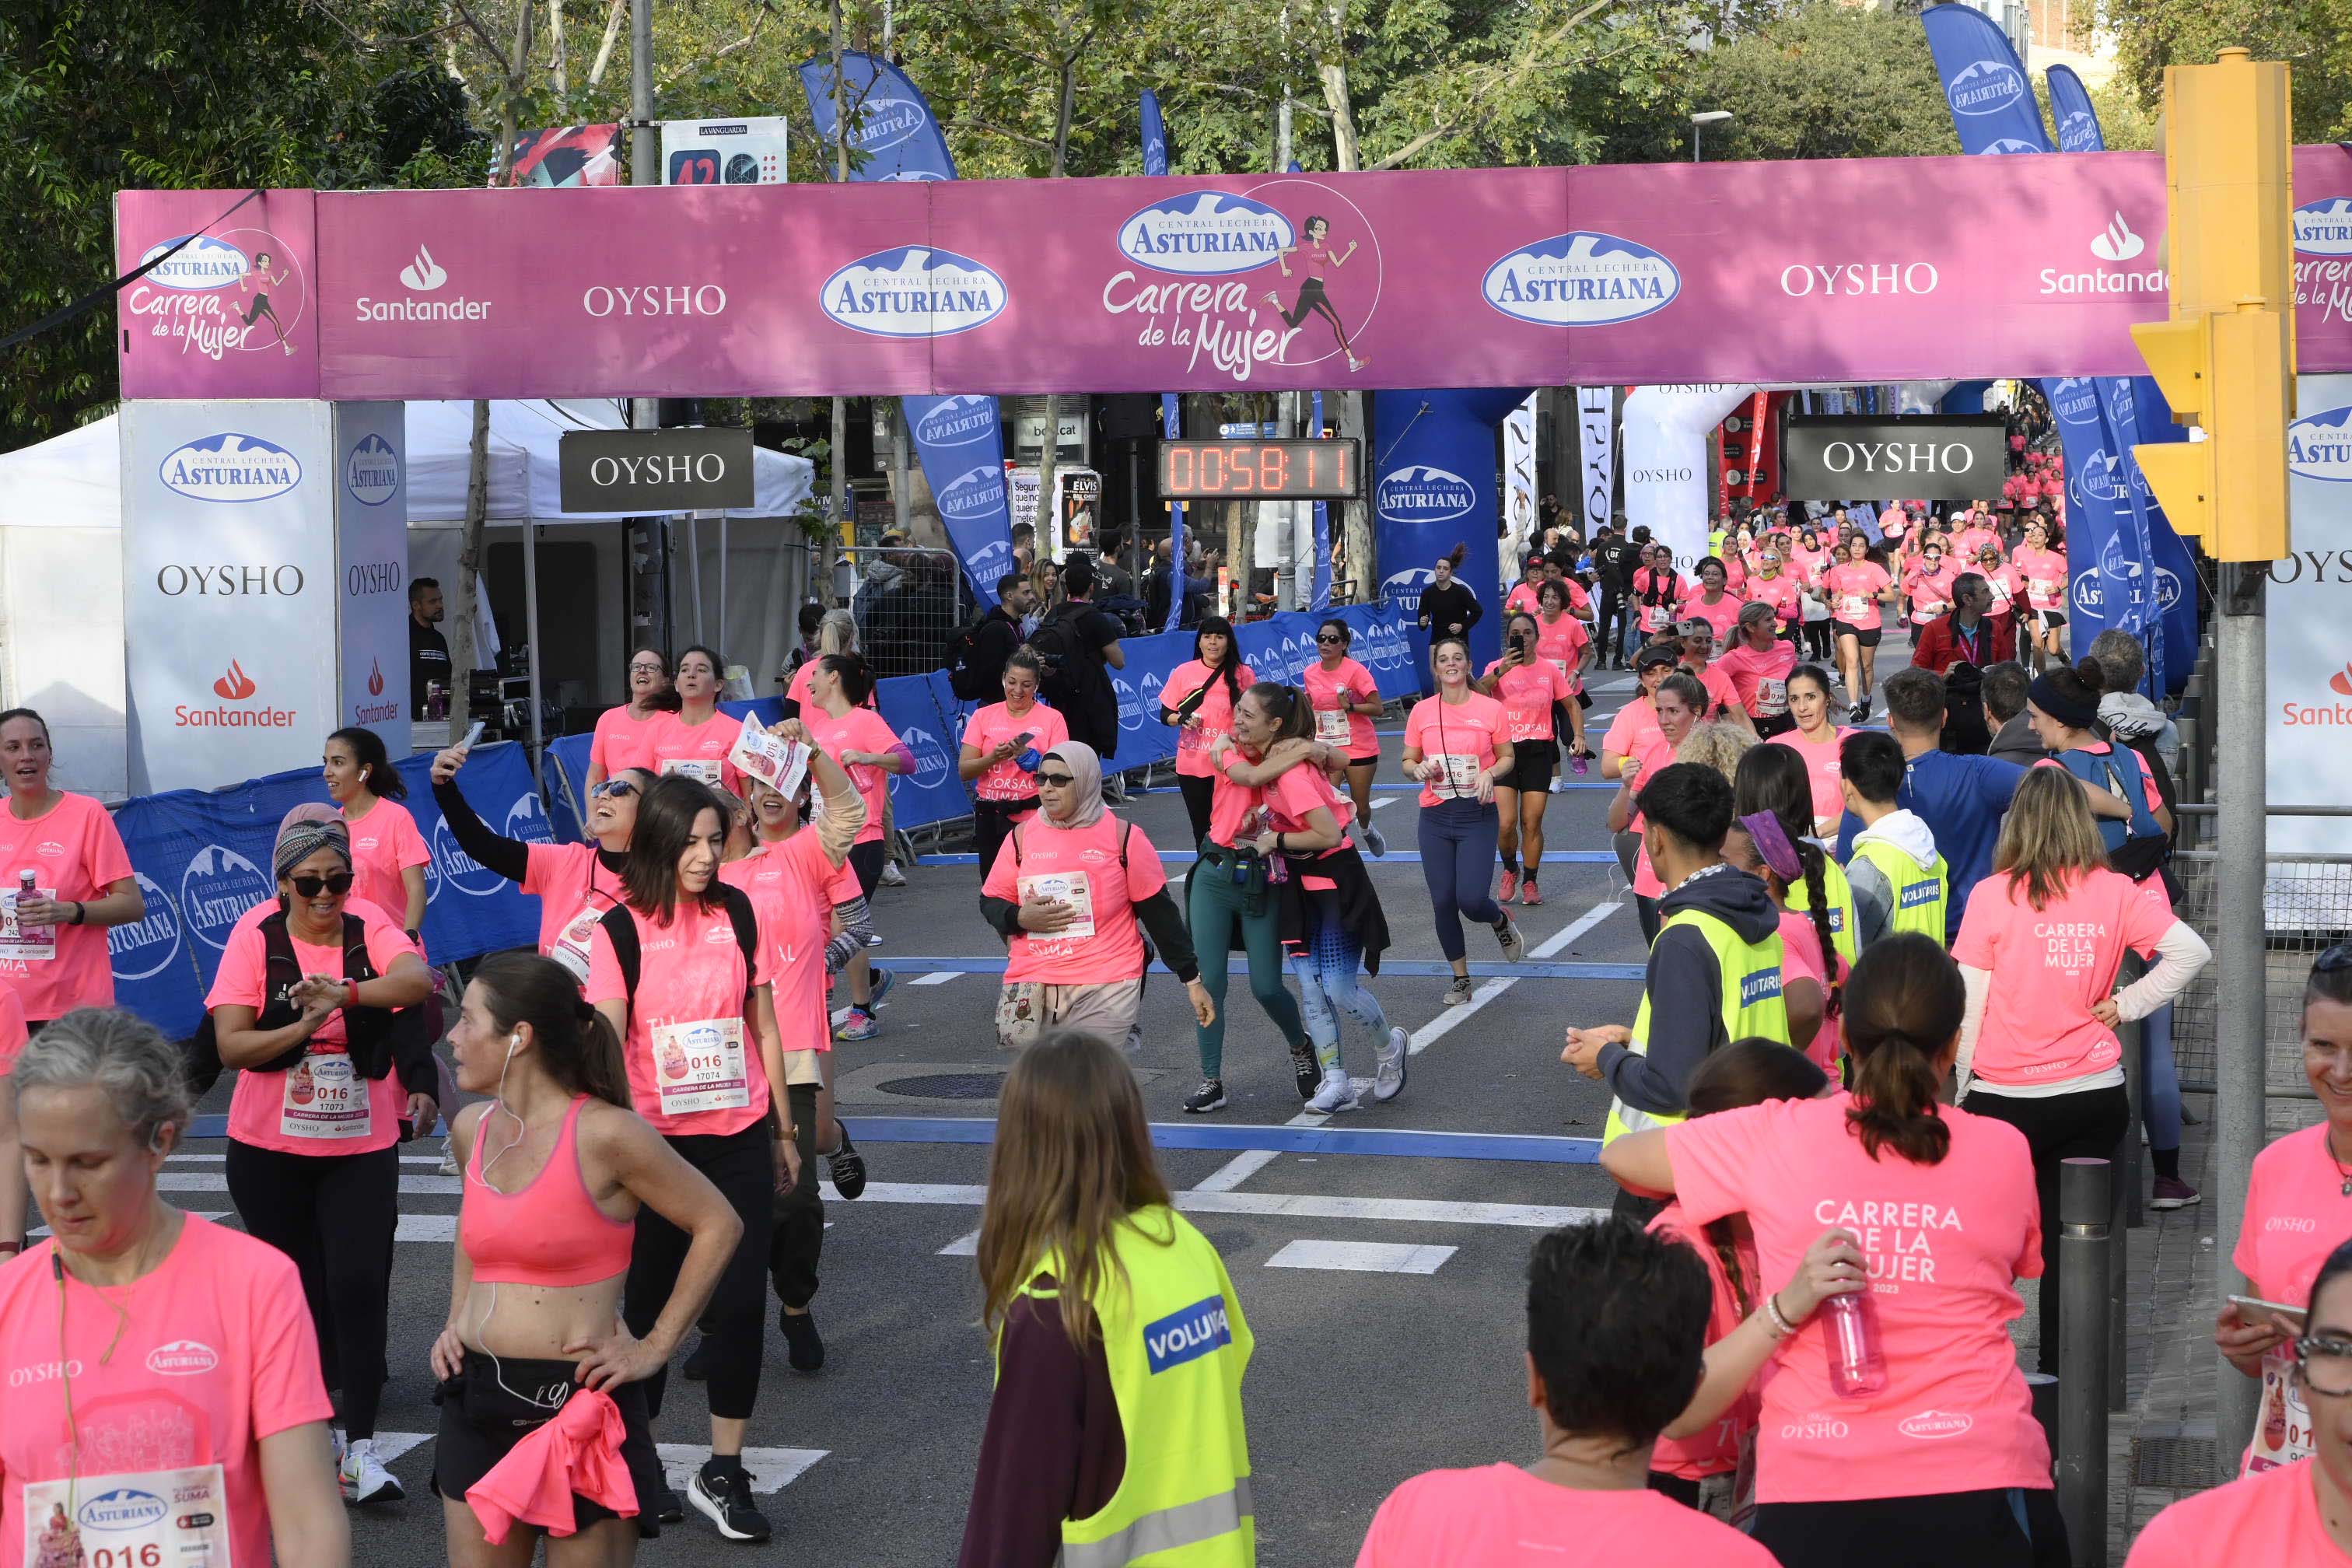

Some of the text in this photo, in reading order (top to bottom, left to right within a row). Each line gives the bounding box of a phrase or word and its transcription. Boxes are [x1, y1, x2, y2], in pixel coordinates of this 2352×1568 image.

[708, 125, 747, 135] VANGUARDIA
[1158, 219, 1276, 229] CENTRAL LECHERA
[1132, 222, 1279, 254] ASTURIANA
[148, 254, 240, 276] ASTURIANA
[1528, 263, 1659, 275] CENTRAL LECHERA
[863, 276, 989, 287] CENTRAL LECHERA
[1497, 268, 1665, 303] ASTURIANA
[1780, 262, 1938, 297] OYSHO
[129, 286, 221, 315] Carrera
[583, 285, 726, 317] OYSHO
[835, 280, 992, 313] ASTURIANA
[1102, 271, 1249, 315] Carrera
[2312, 282, 2326, 304] la
[356, 296, 492, 322] Santander
[152, 312, 255, 360] de la Mujer
[1139, 307, 1303, 381] de la Mujer
[1822, 441, 1974, 474] OYSHO
[170, 459, 292, 485] ASTURIANA
[351, 460, 396, 488] ASTURIANA
[590, 453, 725, 486] OYSHO
[1171, 447, 1344, 491] 00:58:11
[1633, 468, 1692, 483] OYSHO
[1073, 481, 1097, 491] ELVIS
[1381, 488, 1468, 510] ASTURIANA
[157, 565, 304, 596] OYSHO
[348, 561, 401, 597] OYSHO
[174, 705, 296, 727] Santander
[355, 700, 399, 726] Santander
[1507, 711, 1521, 721] TU
[767, 741, 778, 758] 016
[2034, 922, 2105, 937] CARRERA
[2048, 938, 2093, 953] DE LA
[2044, 954, 2095, 968] MUJER
[691, 1055, 722, 1070] 016
[2024, 1060, 2067, 1074] OYSHO
[696, 1071, 721, 1081] 17074
[317, 1087, 348, 1101] 016
[672, 1084, 698, 1093] CARRERA
[671, 1097, 700, 1108] OYSHO
[293, 1111, 319, 1119] CARRERA
[289, 1122, 319, 1132] OYSHO
[1815, 1199, 1963, 1232] CARRERA
[2266, 1216, 2315, 1234] OYSHO
[1895, 1230, 1933, 1255] LA
[1866, 1255, 1936, 1283] UJER
[1873, 1283, 1899, 1294] 2023
[155, 1353, 212, 1367] ASTURIANA
[9, 1360, 83, 1388] OYSHO
[1780, 1420, 1849, 1439] OYSHO
[1906, 1419, 1967, 1432] ASTURIANA
[86, 1490, 210, 1523] ASTURIANA SUMA
[93, 1544, 161, 1568] 016
